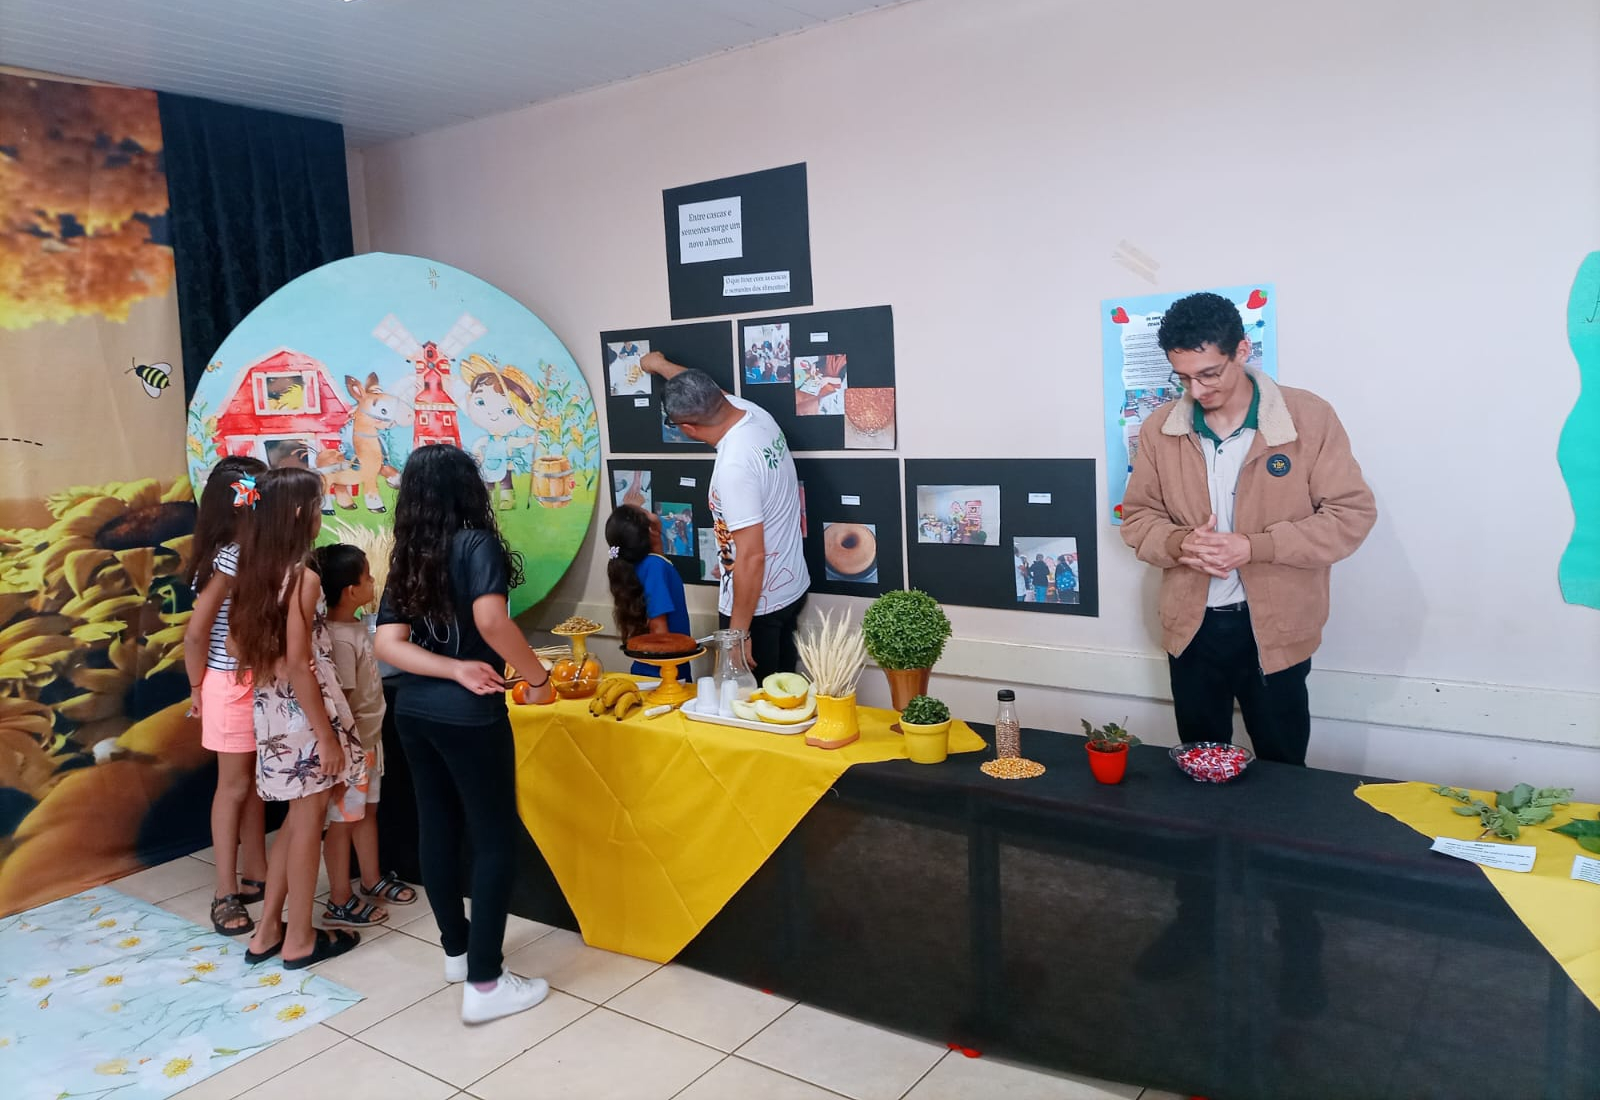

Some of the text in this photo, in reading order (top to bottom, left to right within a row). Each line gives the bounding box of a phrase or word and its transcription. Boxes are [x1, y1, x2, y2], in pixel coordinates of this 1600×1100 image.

[688, 213, 706, 221] Entre
[706, 211, 727, 219] cascas
[681, 222, 741, 236] sementes surge um
[705, 237, 734, 246] alimento.
